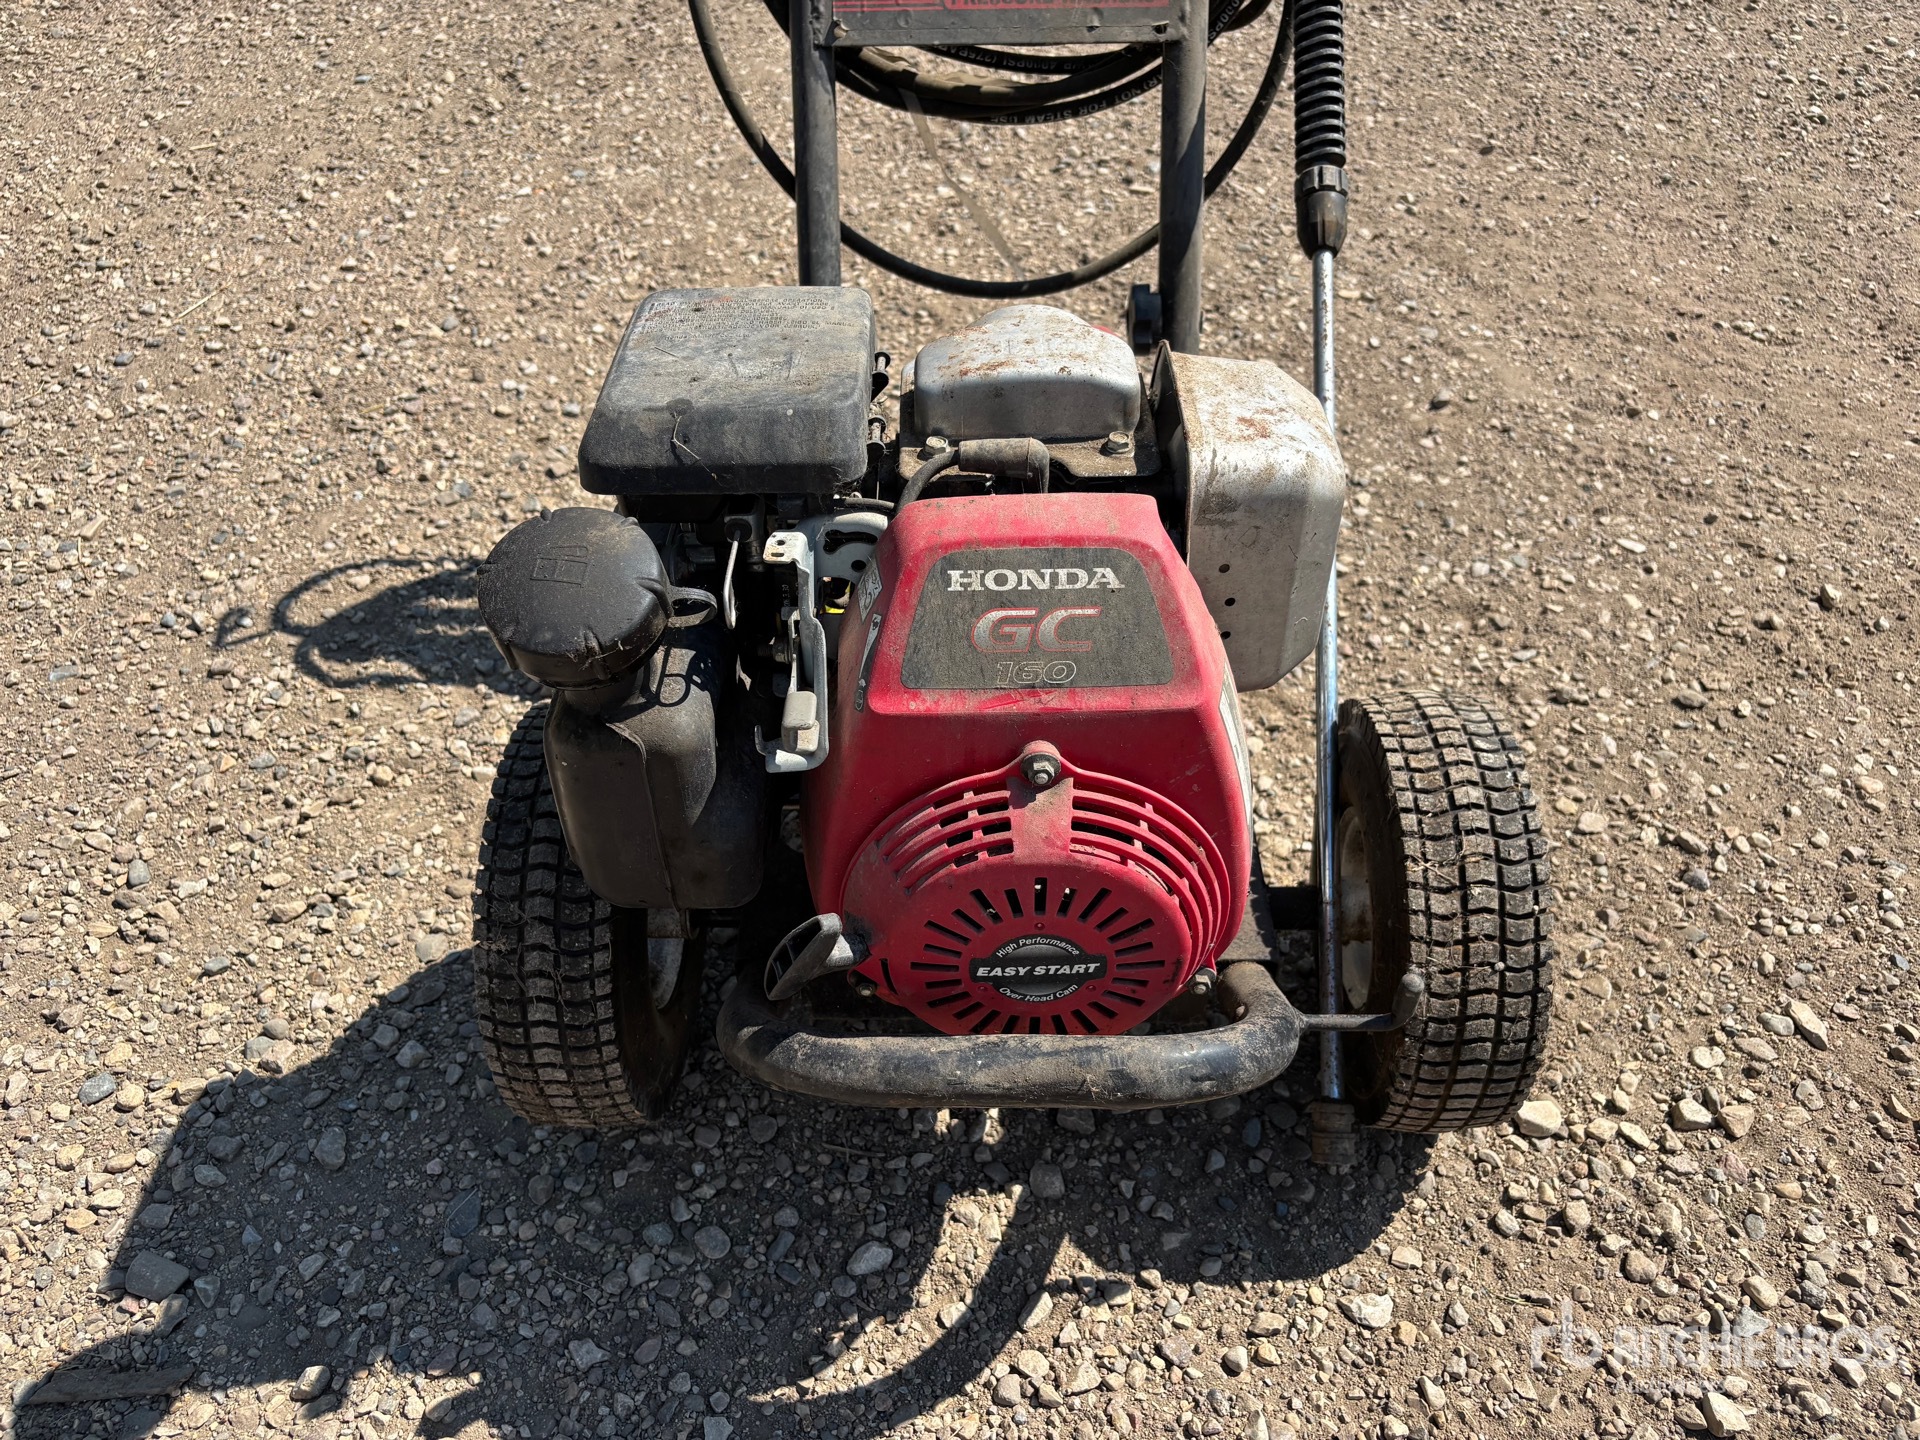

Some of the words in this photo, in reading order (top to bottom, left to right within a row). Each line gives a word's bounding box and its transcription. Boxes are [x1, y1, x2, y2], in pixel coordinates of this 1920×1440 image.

[1113, 87, 1142, 105] NOT
[1024, 108, 1073, 124] STEAM
[1077, 99, 1107, 116] FOR
[947, 567, 1126, 592] HONDA
[970, 606, 1102, 653] GC
[996, 660, 1077, 684] 160
[996, 943, 1018, 958] High
[1019, 936, 1080, 956] Performance
[976, 965, 1031, 977] EASY
[1032, 962, 1101, 976] START
[999, 986, 1024, 1001] Over
[1024, 993, 1054, 1002] Head
[1056, 983, 1079, 999] Cam
